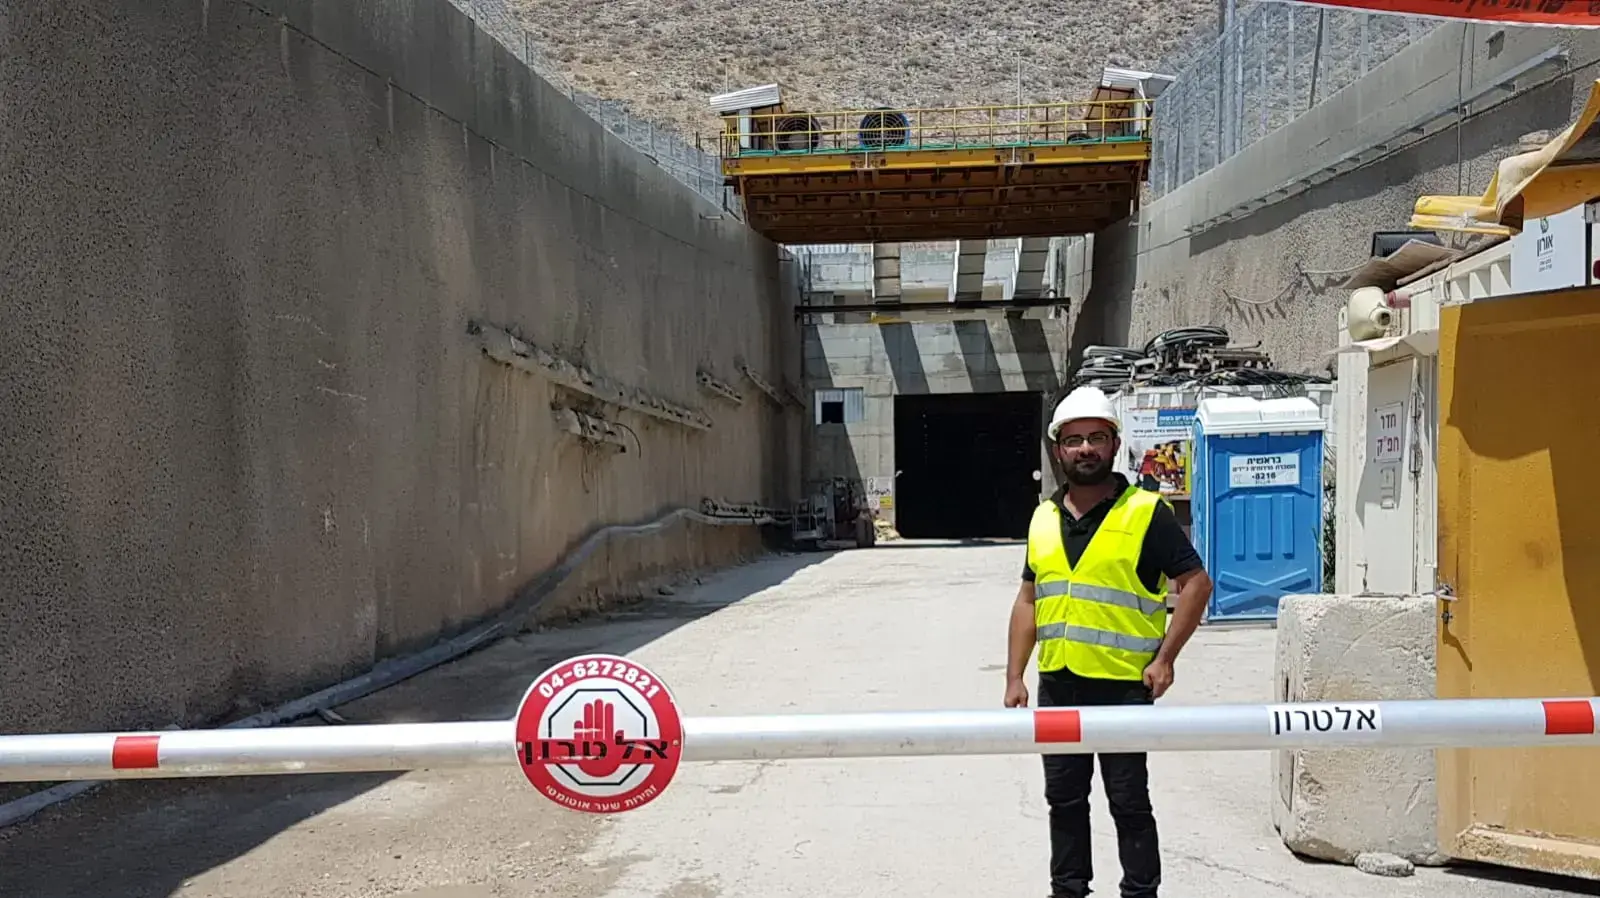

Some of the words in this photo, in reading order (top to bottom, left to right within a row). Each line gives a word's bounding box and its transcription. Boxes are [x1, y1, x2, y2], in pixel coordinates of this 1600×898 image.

[1380, 413, 1397, 430] חדר
[1247, 456, 1282, 465] בראשית
[538, 660, 661, 699] 04-6272821
[1274, 706, 1377, 735] אלטרון
[524, 735, 668, 765] אלטרון
[545, 784, 591, 809] אוטומטי
[594, 801, 621, 811] שער
[624, 784, 657, 807] זהירות
